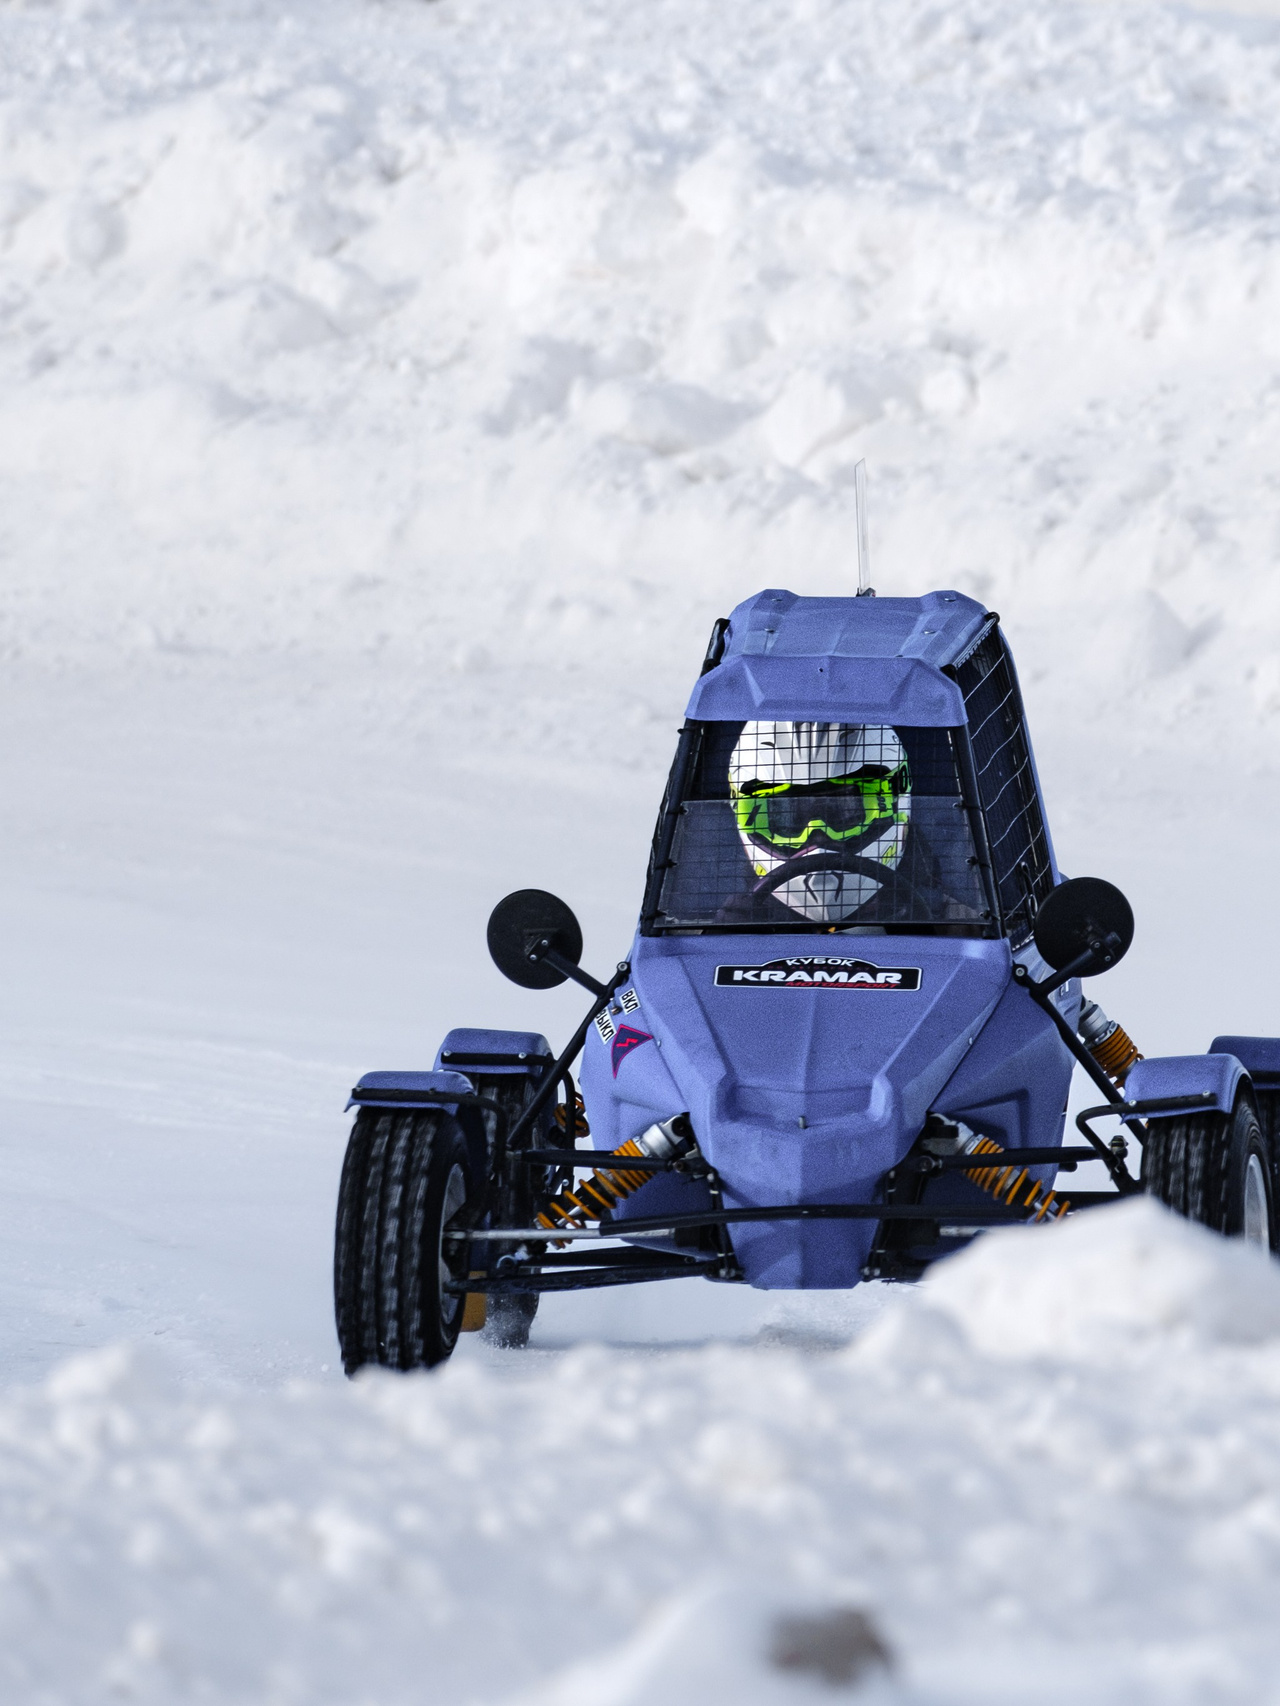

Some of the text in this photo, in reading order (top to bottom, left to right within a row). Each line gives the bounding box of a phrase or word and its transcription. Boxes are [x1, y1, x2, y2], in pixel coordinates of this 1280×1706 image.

[785, 957, 856, 966] КУБОК
[733, 970, 903, 983] KRAMAR
[621, 990, 639, 1013] ВКЛ
